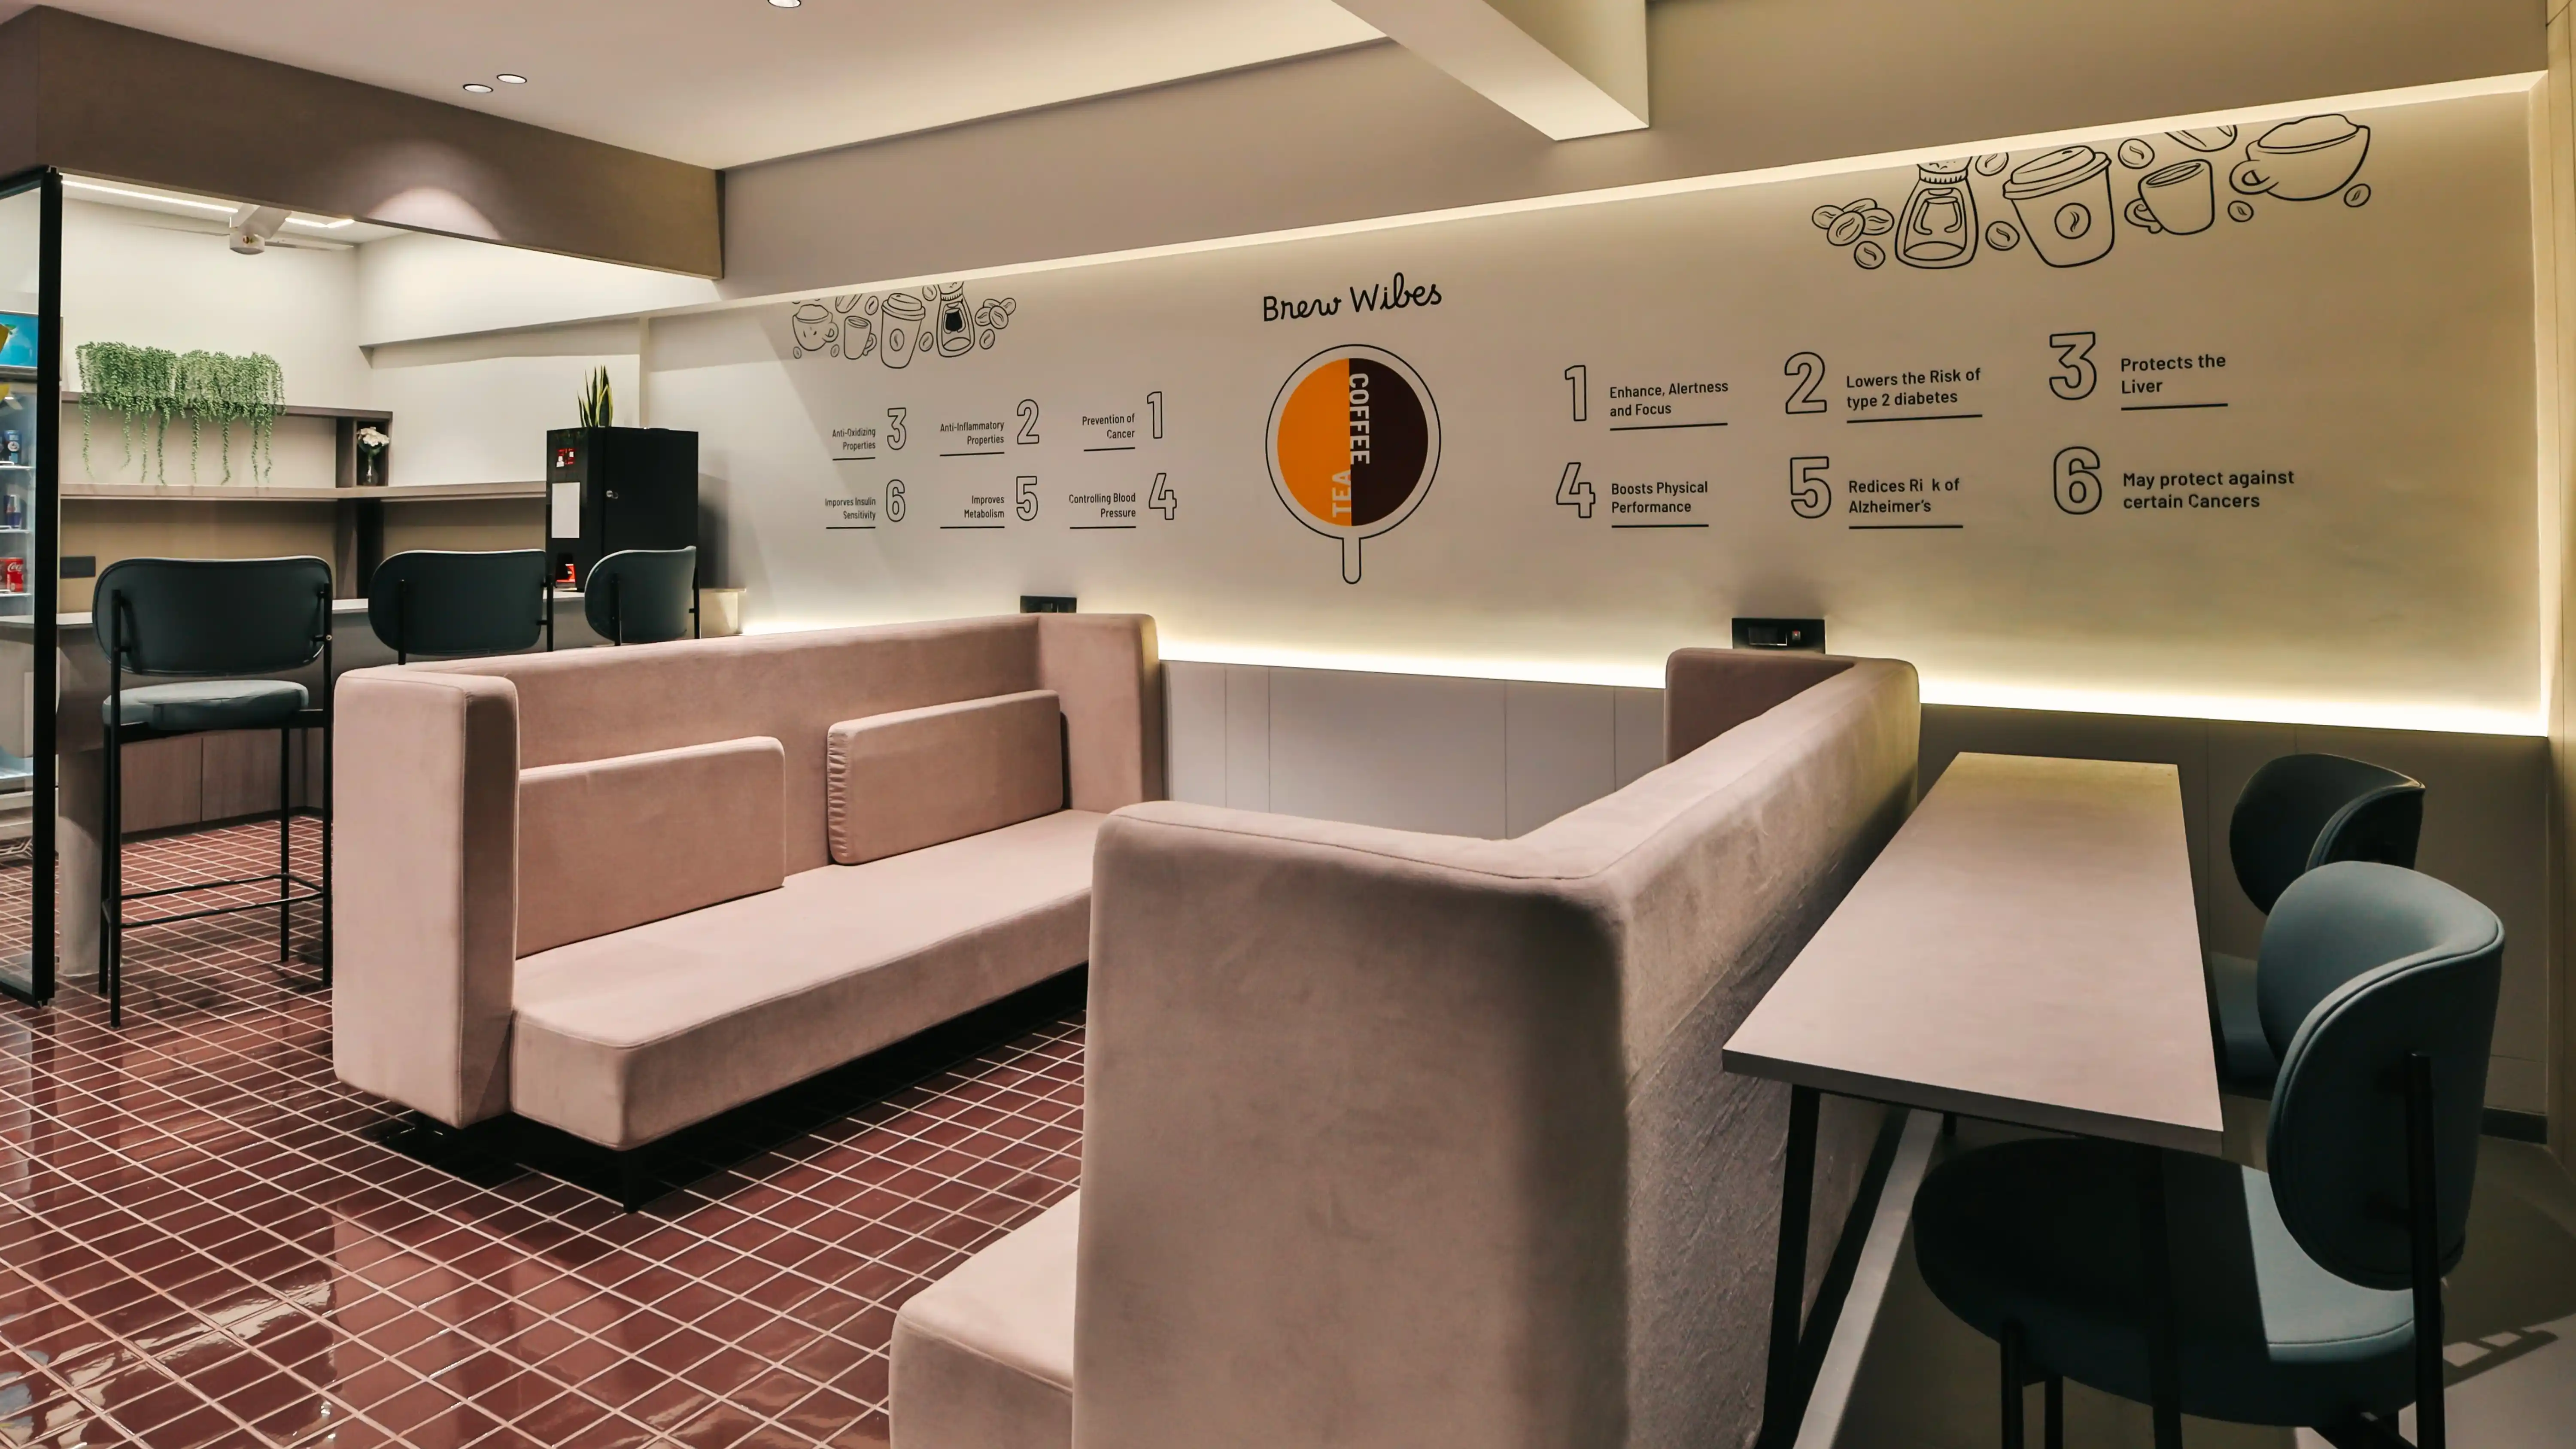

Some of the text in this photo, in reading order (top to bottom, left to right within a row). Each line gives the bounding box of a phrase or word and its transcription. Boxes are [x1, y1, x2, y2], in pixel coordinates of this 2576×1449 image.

[1263, 272, 1442, 322] Brew Wibes
[2048, 331, 2097, 401] 3
[2121, 353, 2226, 372] Protects the
[1784, 351, 1828, 415] 2
[1846, 367, 1981, 388] Lowers the Risk of
[1564, 365, 1587, 422] 1
[1610, 382, 1728, 399] Enhance, Alertness
[2121, 379, 2163, 394] Liver
[1847, 391, 1958, 411] type 2 diabetes
[1146, 391, 1163, 439] 1
[1610, 403, 1671, 417] and Focus
[940, 421, 1005, 432] Anti-Inflammatory
[1016, 398, 1040, 445] 2
[1082, 413, 1135, 426] Prevention of
[1349, 373, 1370, 465] COFFEE
[832, 428, 876, 438] Anti-Oxidizing
[887, 407, 907, 451] 3
[1107, 429, 1135, 439] Cancer
[842, 441, 876, 452] Properties
[967, 434, 1005, 447] Properties
[1611, 480, 1708, 497] Boosts Physical
[1789, 456, 1832, 519] 5
[1849, 479, 1905, 493] Redices
[1944, 477, 1960, 492] of
[2053, 446, 2102, 515] 6
[2123, 470, 2295, 490] May protect against
[1016, 475, 1039, 522] 5
[1069, 492, 1136, 505] Controlling Blood
[1148, 472, 1177, 521] 4
[1332, 469, 1352, 518] TEA
[1555, 462, 1596, 519] 4
[825, 497, 876, 508] Imporves Insulin
[886, 479, 906, 523] 6
[972, 495, 1005, 506] Improves
[1612, 501, 1692, 513] Performance
[1848, 499, 1931, 513] Alzheimer's
[2123, 493, 2260, 509] certain Cancers
[843, 510, 876, 521] Sensitivity
[964, 508, 1005, 519] Metabolism
[1100, 508, 1136, 518] Pressure
